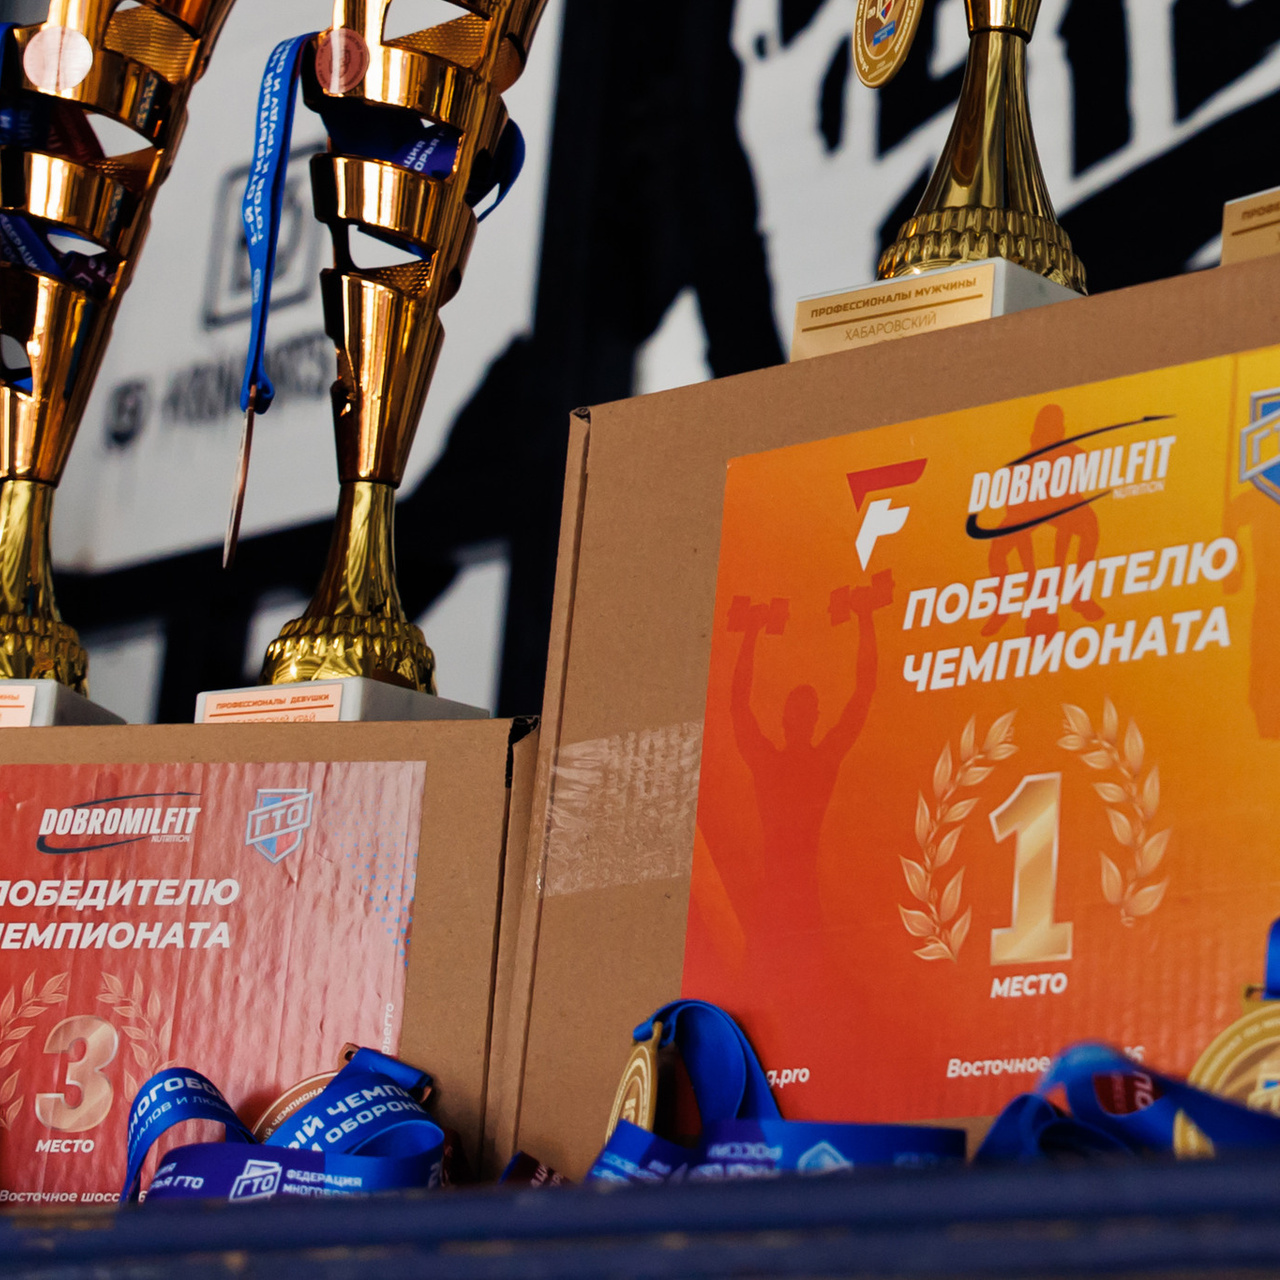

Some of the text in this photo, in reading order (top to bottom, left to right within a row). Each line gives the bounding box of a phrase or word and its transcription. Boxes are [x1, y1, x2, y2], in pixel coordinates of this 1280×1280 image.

[810, 277, 977, 318] ПРОФЕССИОНАЛЫ МУЖЧИНЫ
[843, 310, 937, 341] ХАБАРОВСКИЙ
[968, 435, 1177, 513] DOBROMILFIT
[903, 537, 1239, 631] ПОБЕДИТЕЛЮ
[903, 606, 1232, 693] ЧЕМПИОНАТА
[290, 695, 330, 704] ДЕВУШКИ
[39, 807, 202, 836] DOBROMILFIT
[255, 803, 305, 837] ГТО
[988, 771, 1074, 965] 1
[0, 921, 231, 950] ЕМПИОНАТА
[990, 972, 1068, 999] МЕСТО
[35, 1014, 120, 1134] 3
[946, 1054, 1052, 1079] Восточное
[35, 1138, 96, 1155] МЕСТО
[173, 1175, 205, 1189] ГТО
[237, 1175, 275, 1198] ГТО
[286, 1169, 363, 1187] ФЕДЕРАЦИЯ
[0, 1190, 78, 1203] Восточное
